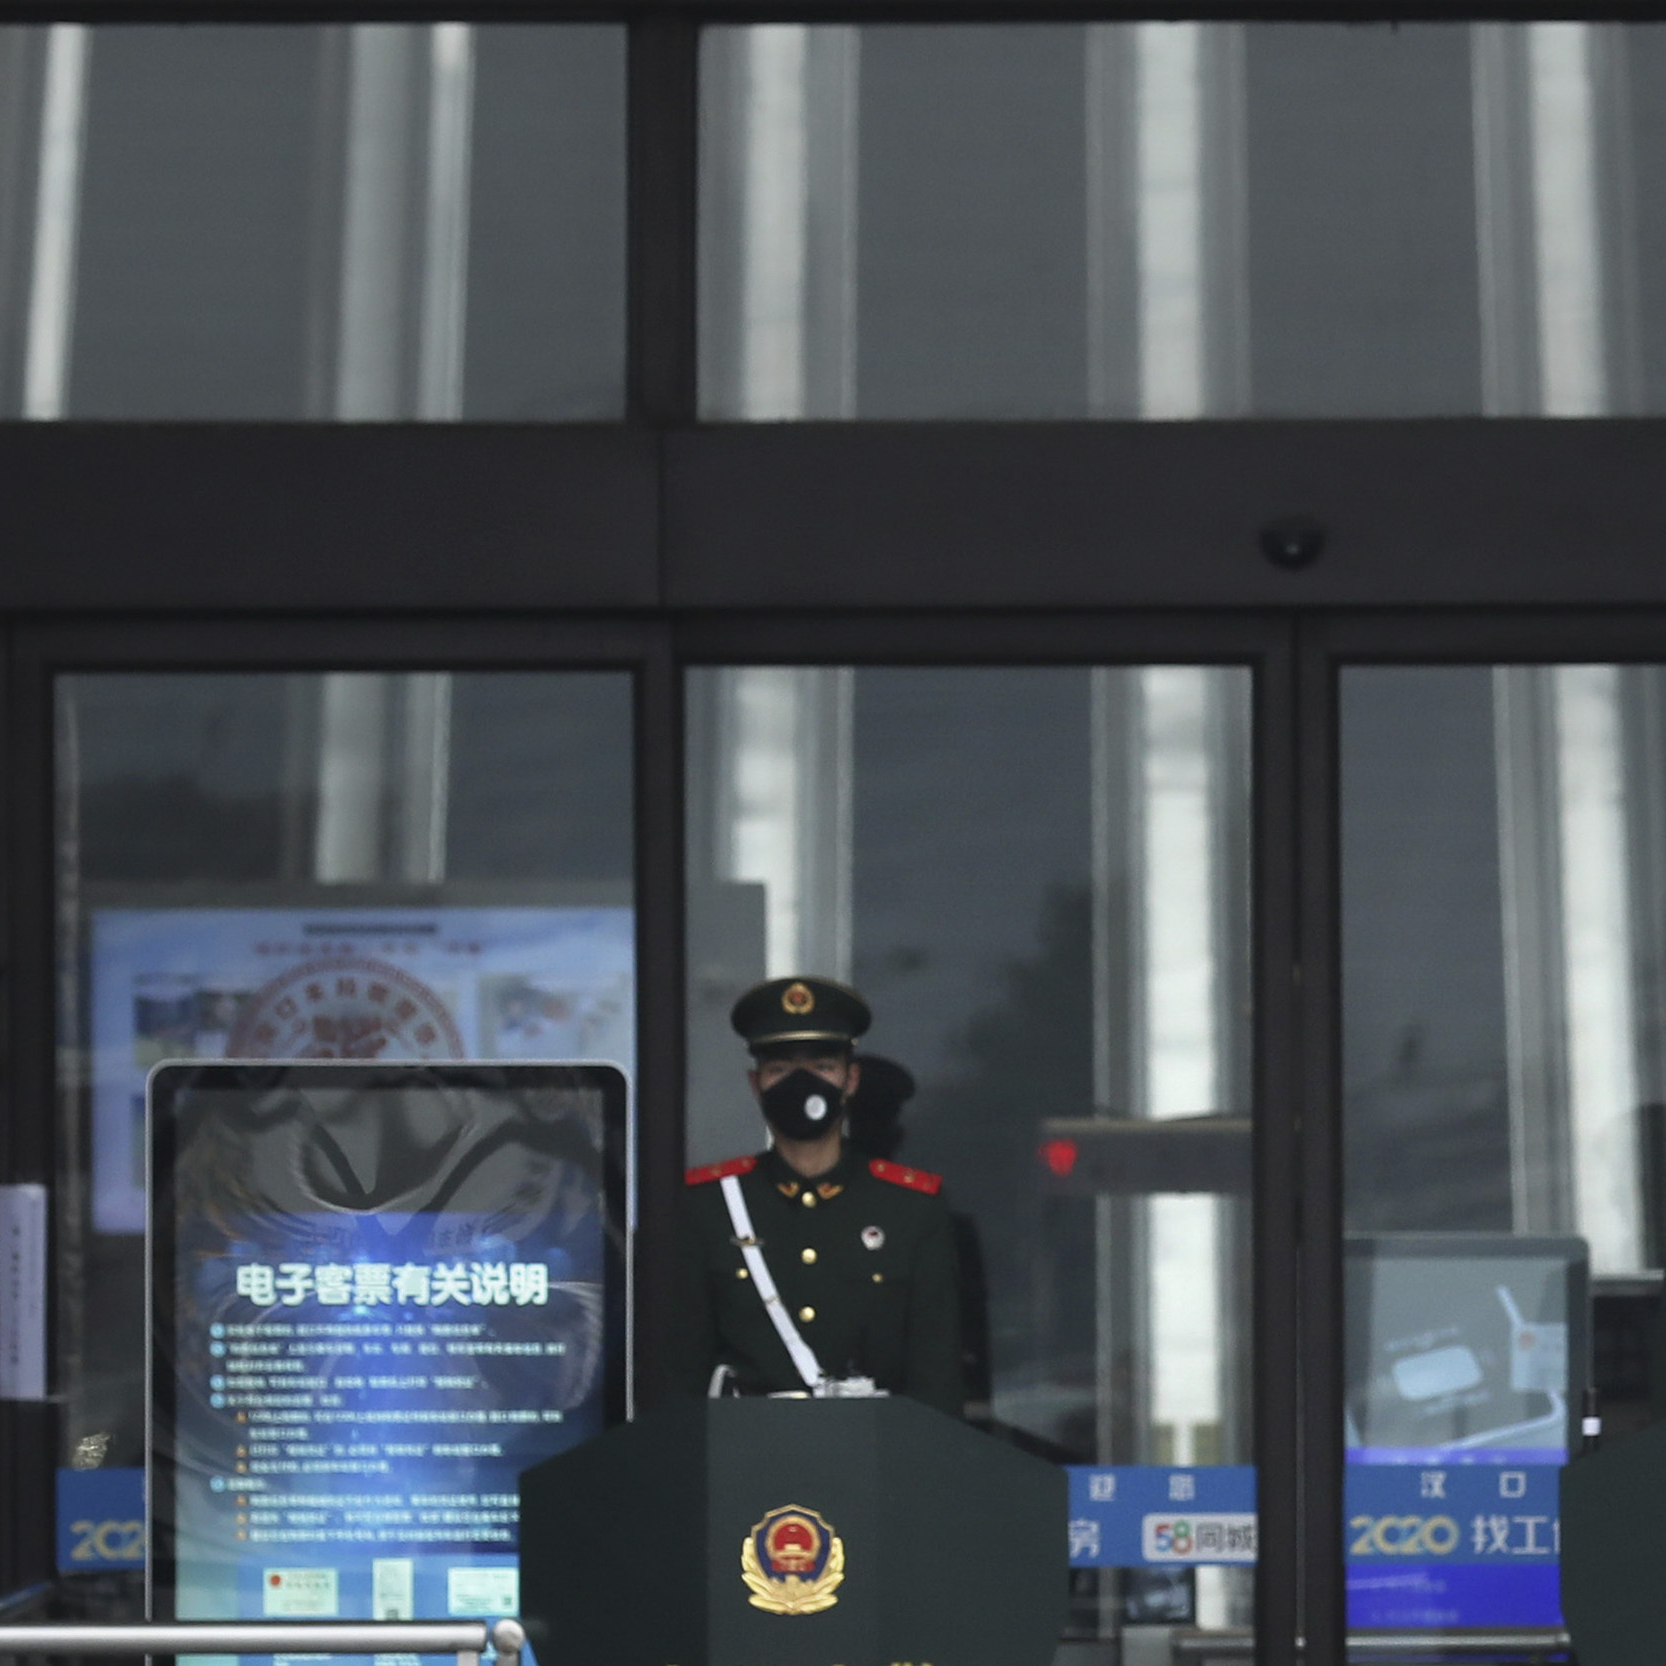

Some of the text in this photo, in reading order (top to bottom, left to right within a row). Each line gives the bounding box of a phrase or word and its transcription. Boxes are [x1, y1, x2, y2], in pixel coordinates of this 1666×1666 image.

[236, 1263, 549, 1306] 电子客票有关说明
[1154, 1519, 1257, 1556] 58同城
[1349, 1513, 1560, 1556] 2020 找工
